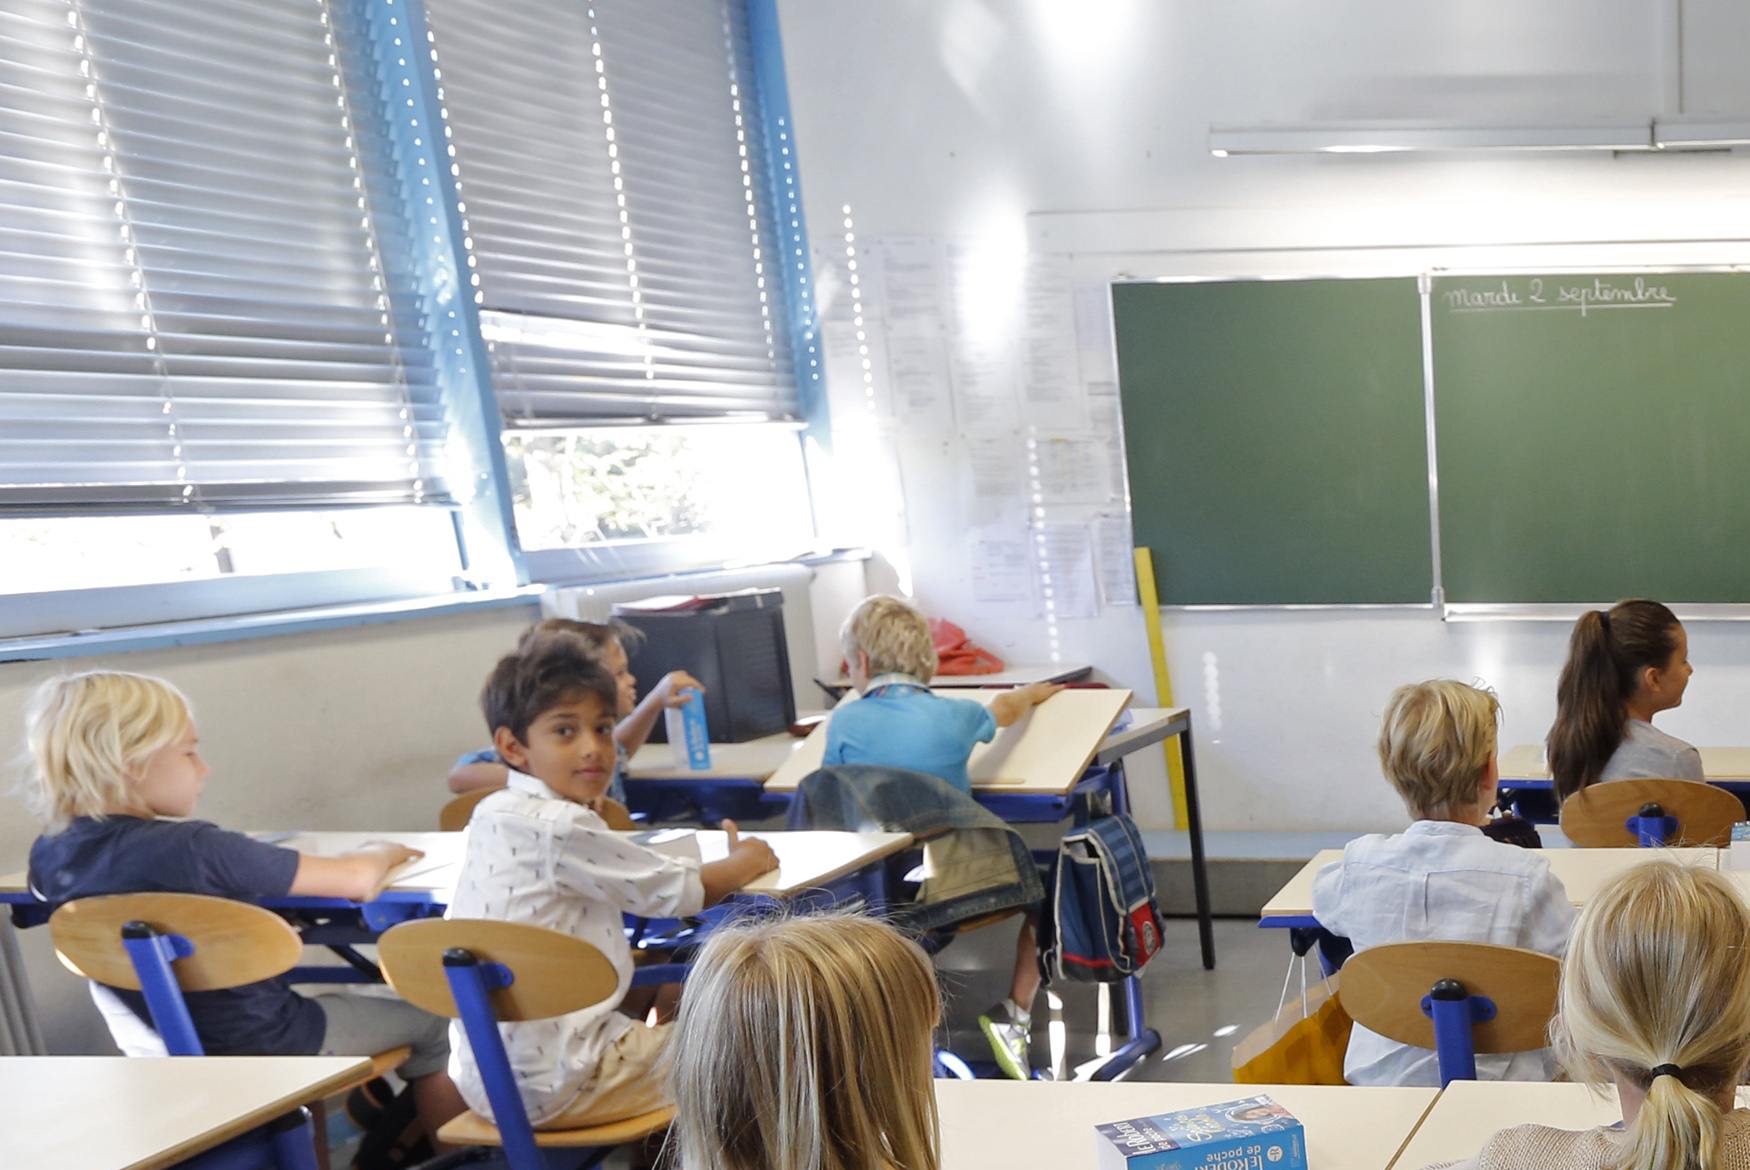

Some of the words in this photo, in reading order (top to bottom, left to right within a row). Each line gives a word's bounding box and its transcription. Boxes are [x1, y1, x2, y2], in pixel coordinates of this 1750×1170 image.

[1528, 278, 1546, 303] 2
[1559, 277, 1677, 317] septembre
[1205, 1147, 1243, 1163] poche
[1246, 1144, 1262, 1155] de
